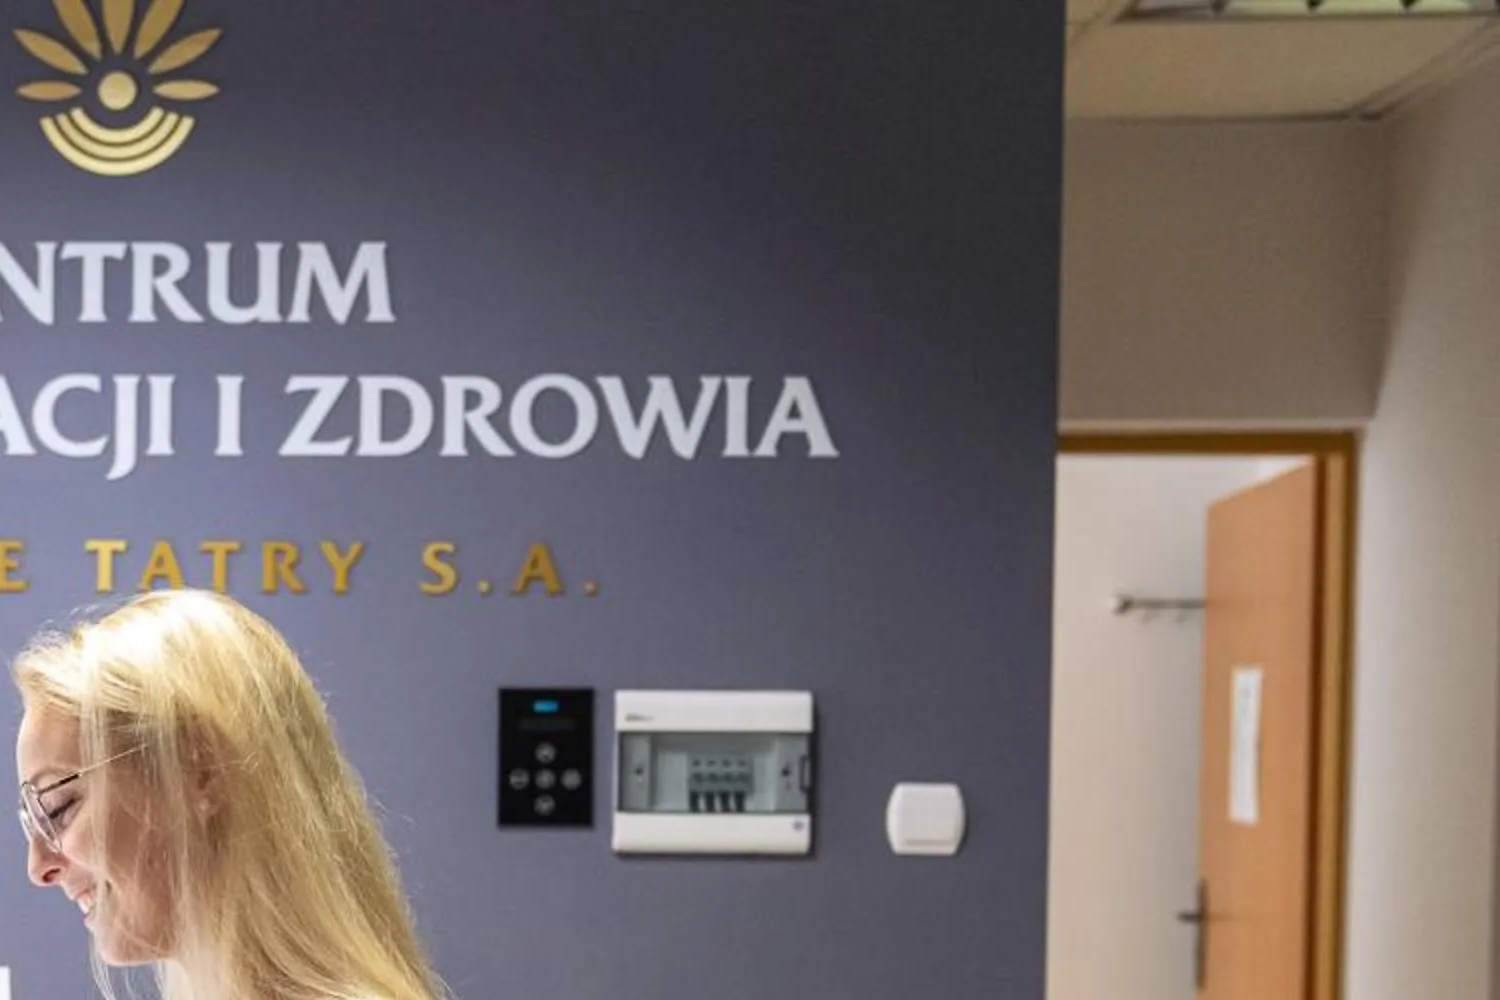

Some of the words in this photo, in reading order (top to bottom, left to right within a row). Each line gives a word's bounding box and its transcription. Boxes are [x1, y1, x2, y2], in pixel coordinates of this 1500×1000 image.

[212, 373, 246, 458] I
[277, 374, 838, 460] ZDROWIA
[84, 539, 365, 597] TATRY
[419, 541, 600, 597] S.A.
